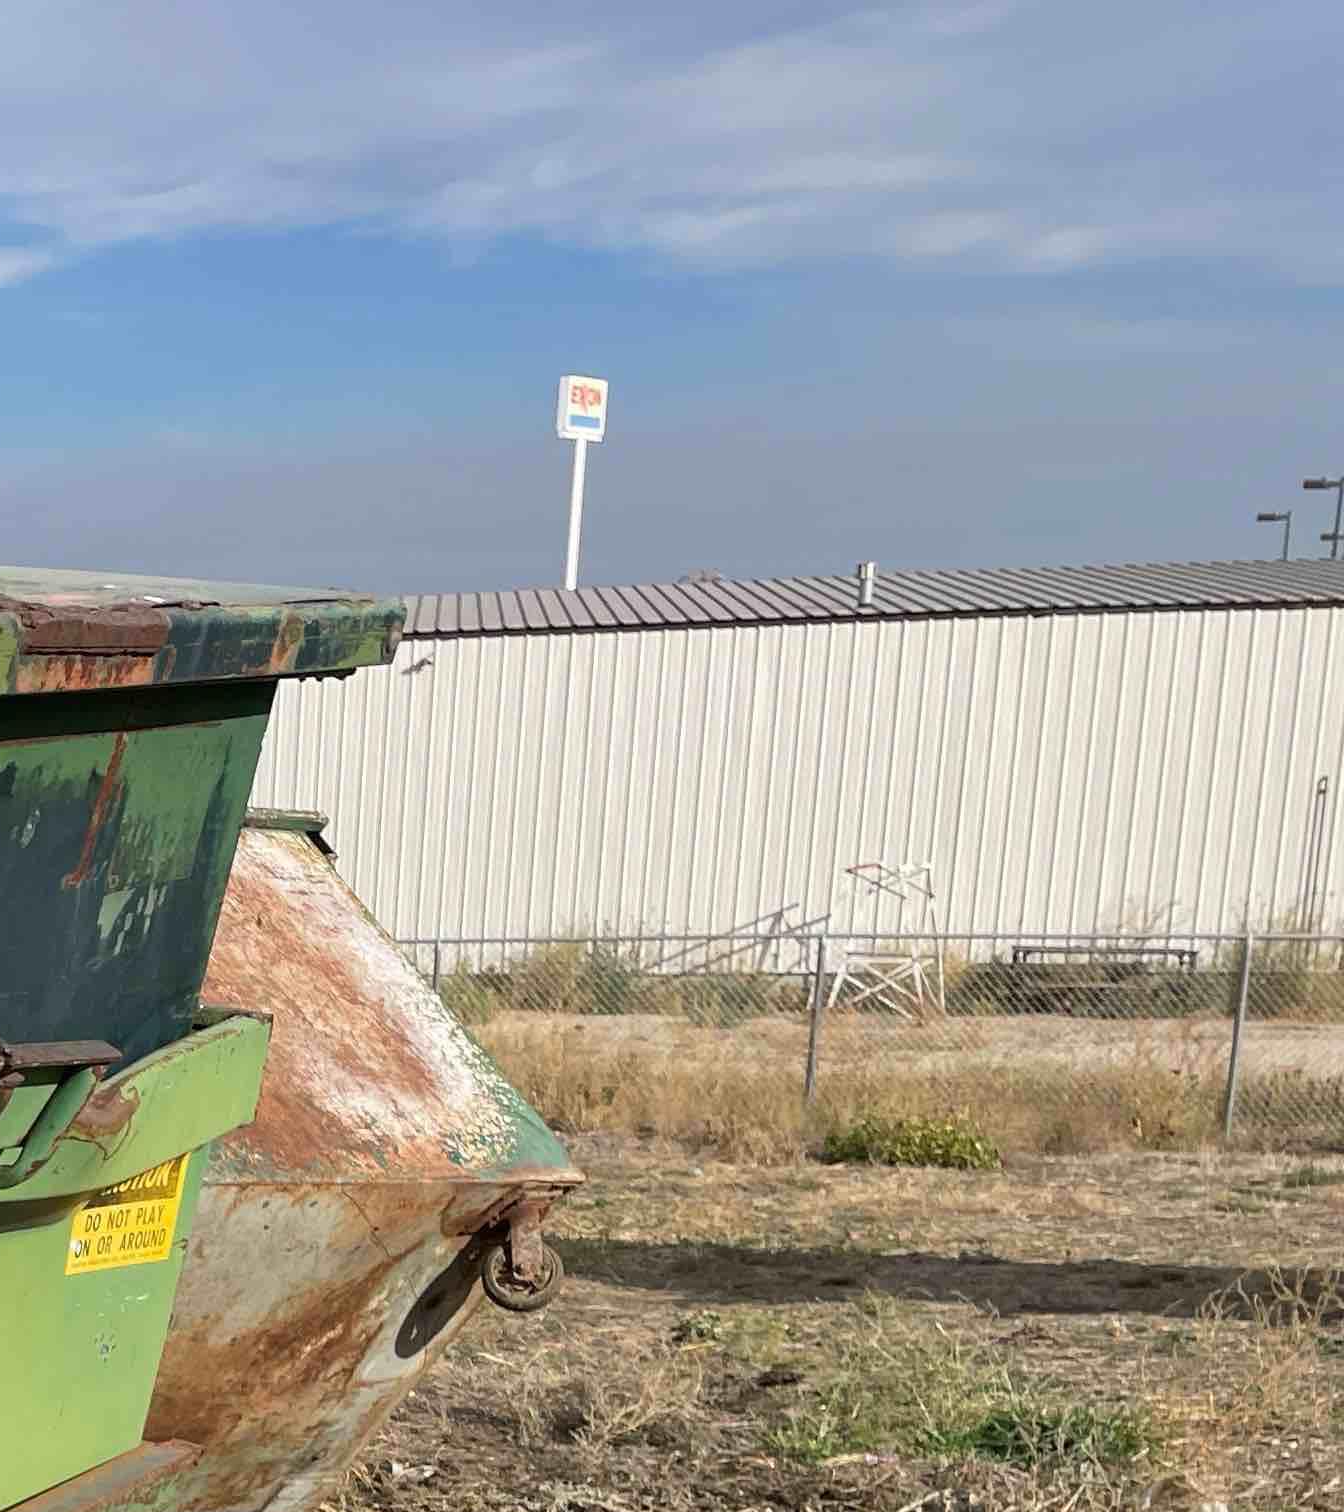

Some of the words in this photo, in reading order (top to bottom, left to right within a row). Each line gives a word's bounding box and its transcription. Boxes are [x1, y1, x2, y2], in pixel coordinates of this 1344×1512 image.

[85, 1214, 101, 1232] DO
[107, 1209, 131, 1229] NOT
[136, 1205, 165, 1225] PLAY
[74, 1240, 91, 1258] ON
[97, 1235, 112, 1255] OR
[120, 1229, 166, 1251] AROUND
